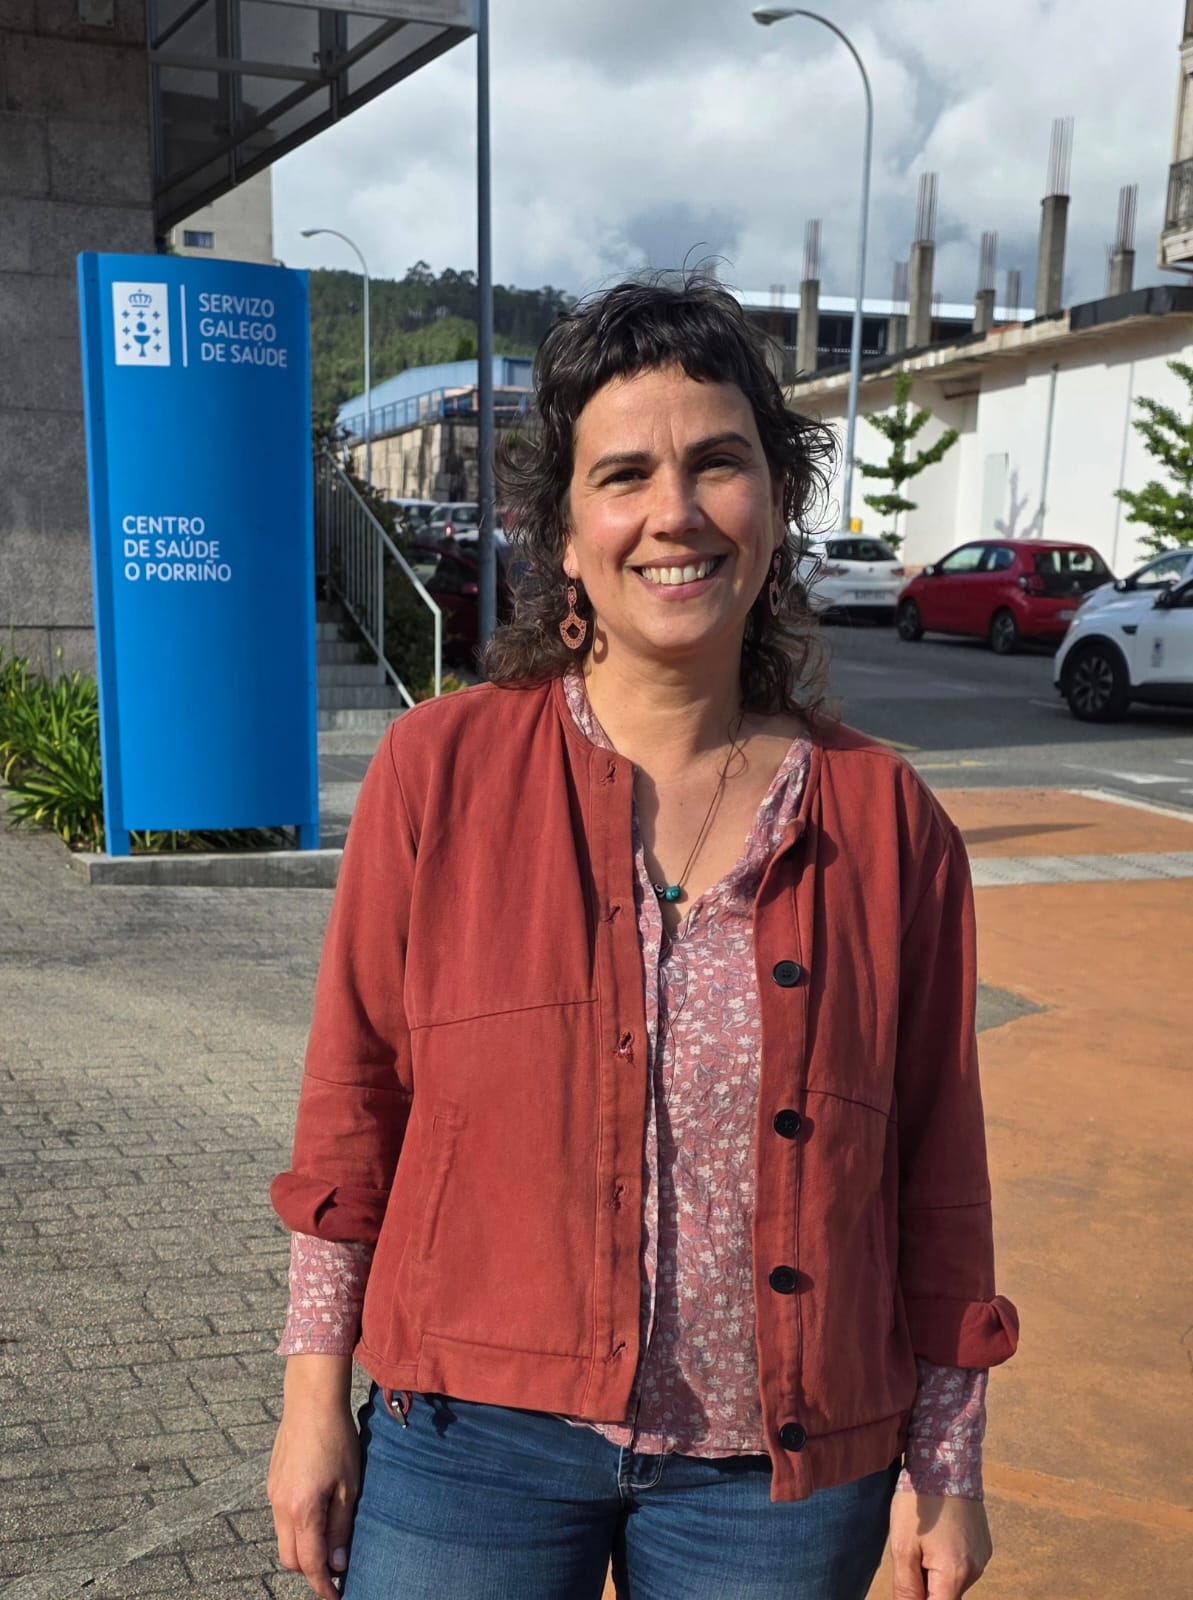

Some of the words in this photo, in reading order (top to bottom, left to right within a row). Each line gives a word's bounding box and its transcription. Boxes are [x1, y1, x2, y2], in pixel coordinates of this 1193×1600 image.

[199, 293, 274, 318] SERVIZO
[200, 318, 276, 342] GALEGO
[201, 342, 226, 362] DE
[231, 342, 288, 368] SAÚDE
[122, 515, 205, 535] CENTRO
[124, 539, 150, 558] DE
[155, 536, 220, 559] SAÚDE
[124, 562, 141, 581] O
[146, 560, 232, 582] PORRIÑO
